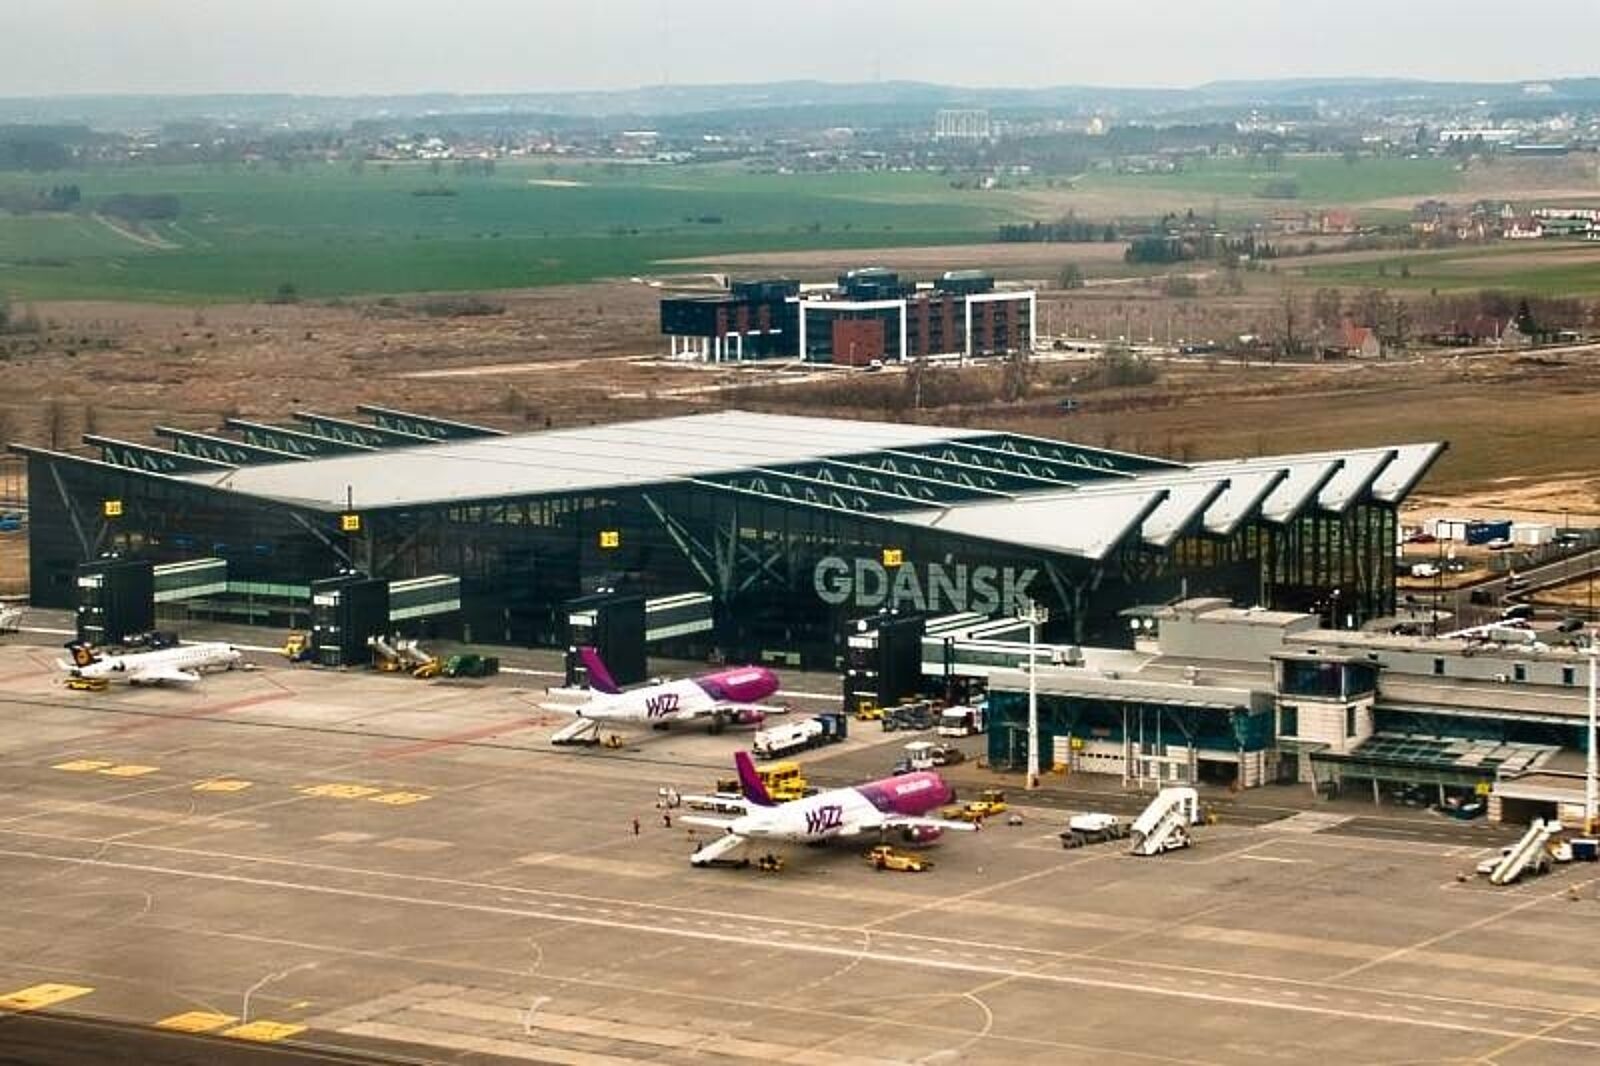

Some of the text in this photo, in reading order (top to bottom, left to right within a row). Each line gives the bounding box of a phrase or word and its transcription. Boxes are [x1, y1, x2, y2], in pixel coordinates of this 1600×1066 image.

[813, 553, 1038, 616] GDAŃSK
[645, 693, 680, 718] WIZZ
[805, 805, 842, 834] WIZZ
